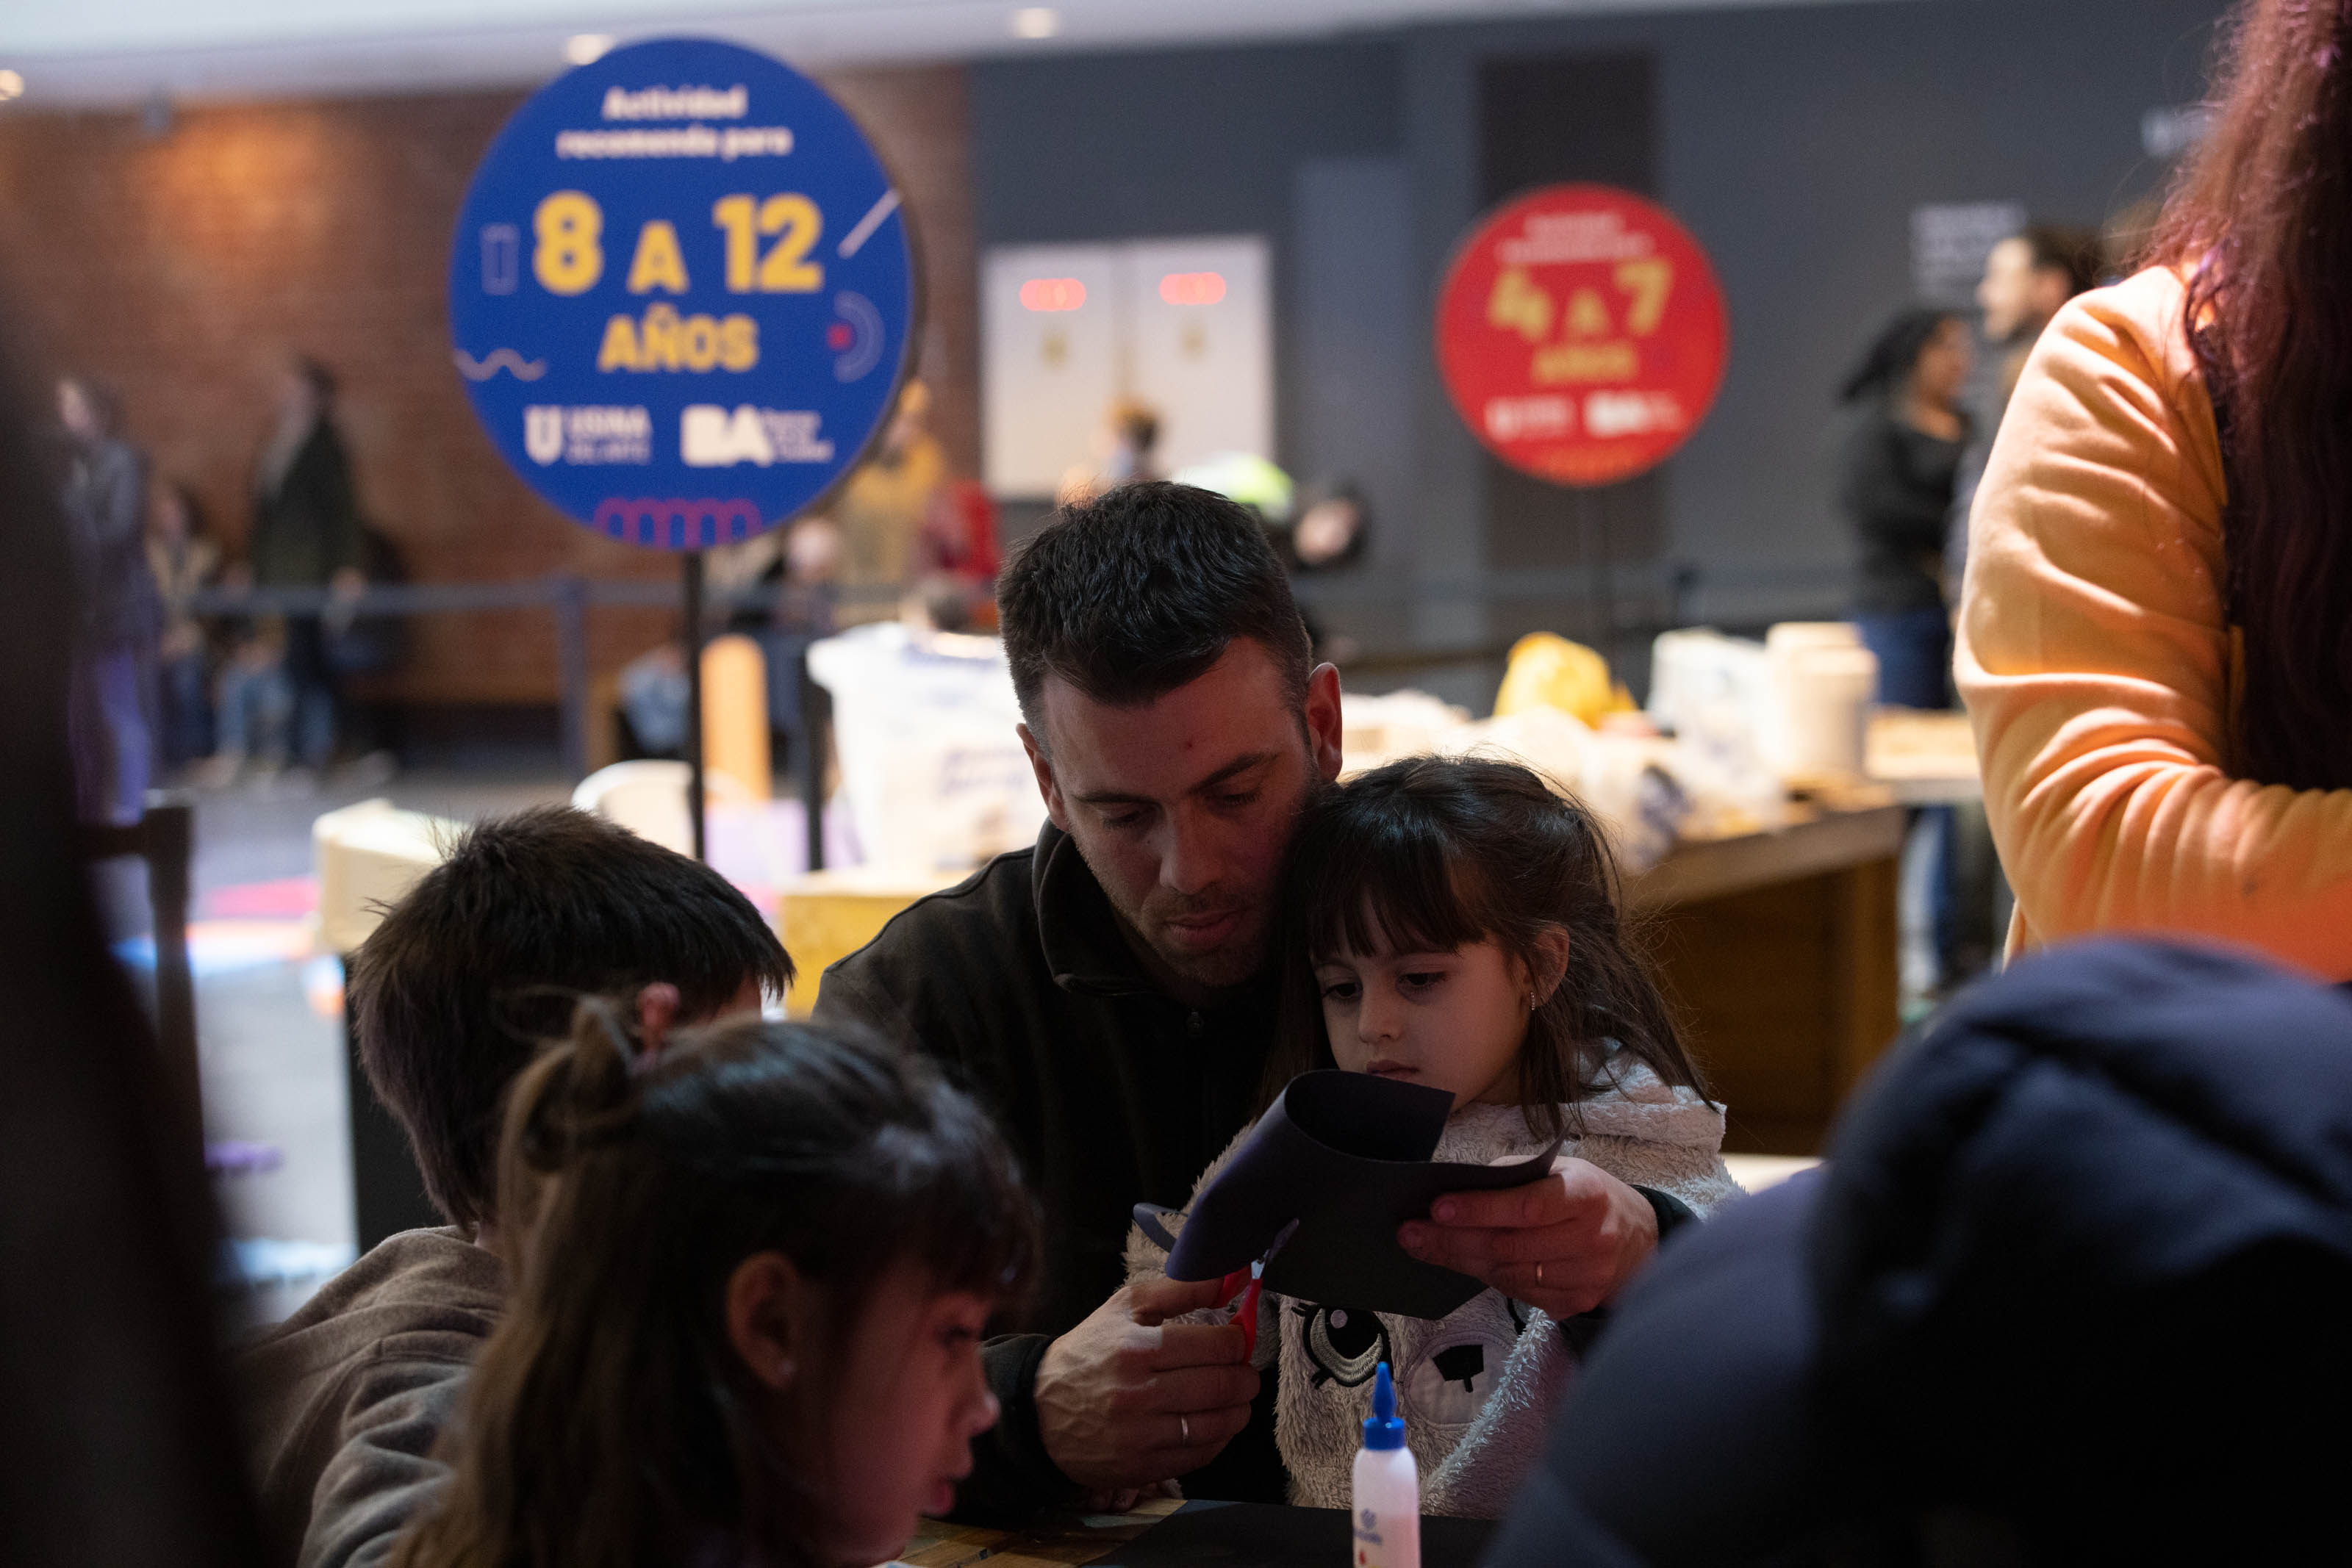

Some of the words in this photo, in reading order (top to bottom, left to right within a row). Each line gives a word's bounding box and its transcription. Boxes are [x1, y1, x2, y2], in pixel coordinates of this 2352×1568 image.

[602, 84, 747, 120] Actividad
[722, 127, 793, 162] para
[534, 191, 603, 295] 8
[628, 220, 689, 294] A
[713, 193, 825, 293] 12
[1487, 263, 1554, 342] 4
[1615, 257, 1673, 335] 7
[598, 302, 760, 373] AÑOS
[524, 405, 562, 465] U
[681, 404, 772, 467] BA
